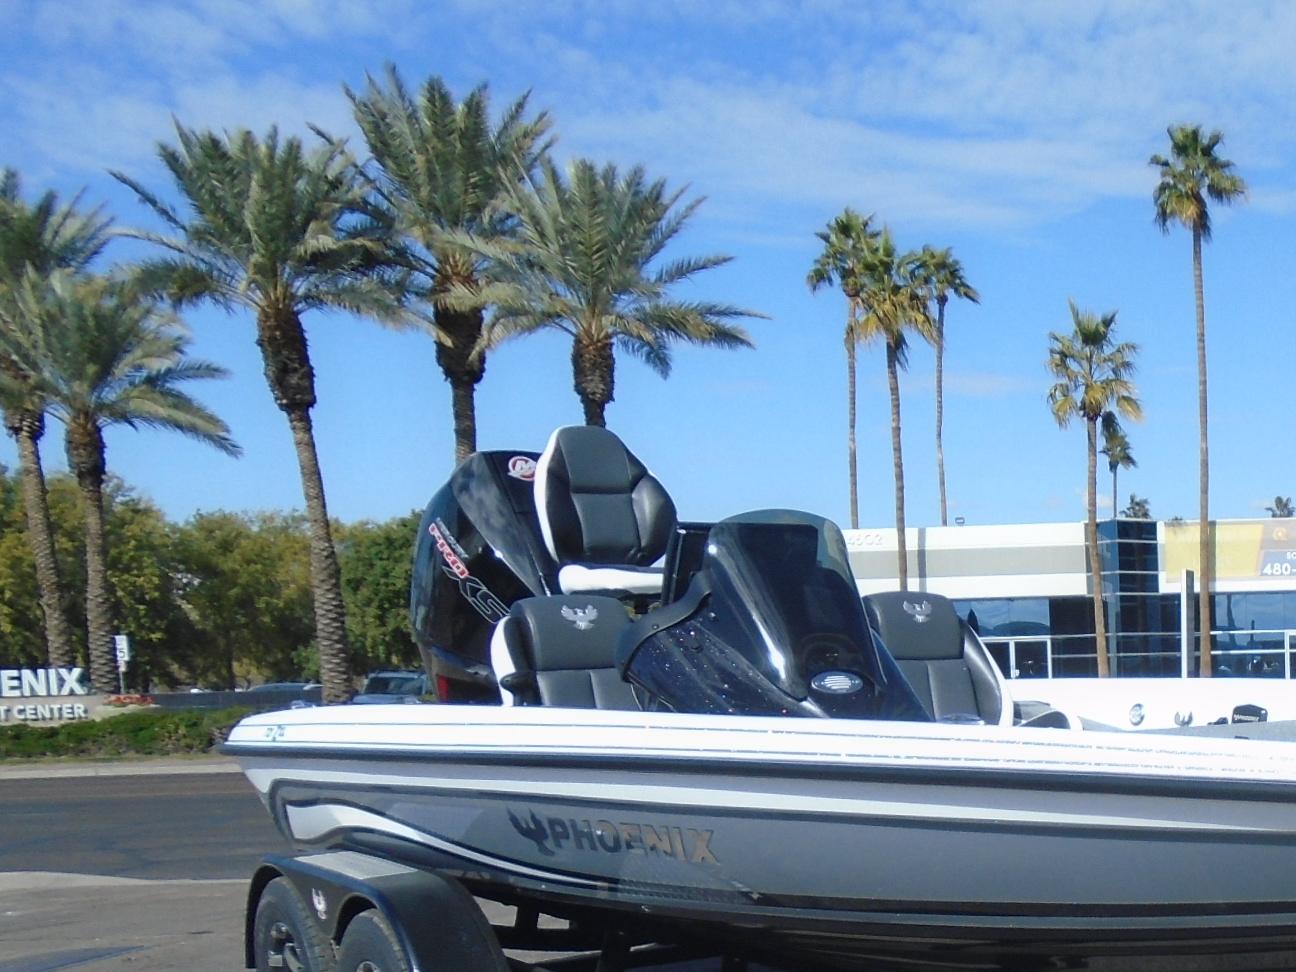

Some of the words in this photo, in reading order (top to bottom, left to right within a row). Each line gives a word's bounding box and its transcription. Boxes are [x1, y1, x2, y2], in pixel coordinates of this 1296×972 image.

[0, 667, 85, 697] ENIX
[13, 703, 87, 720] CENTER
[547, 817, 720, 866] PHOENIX
